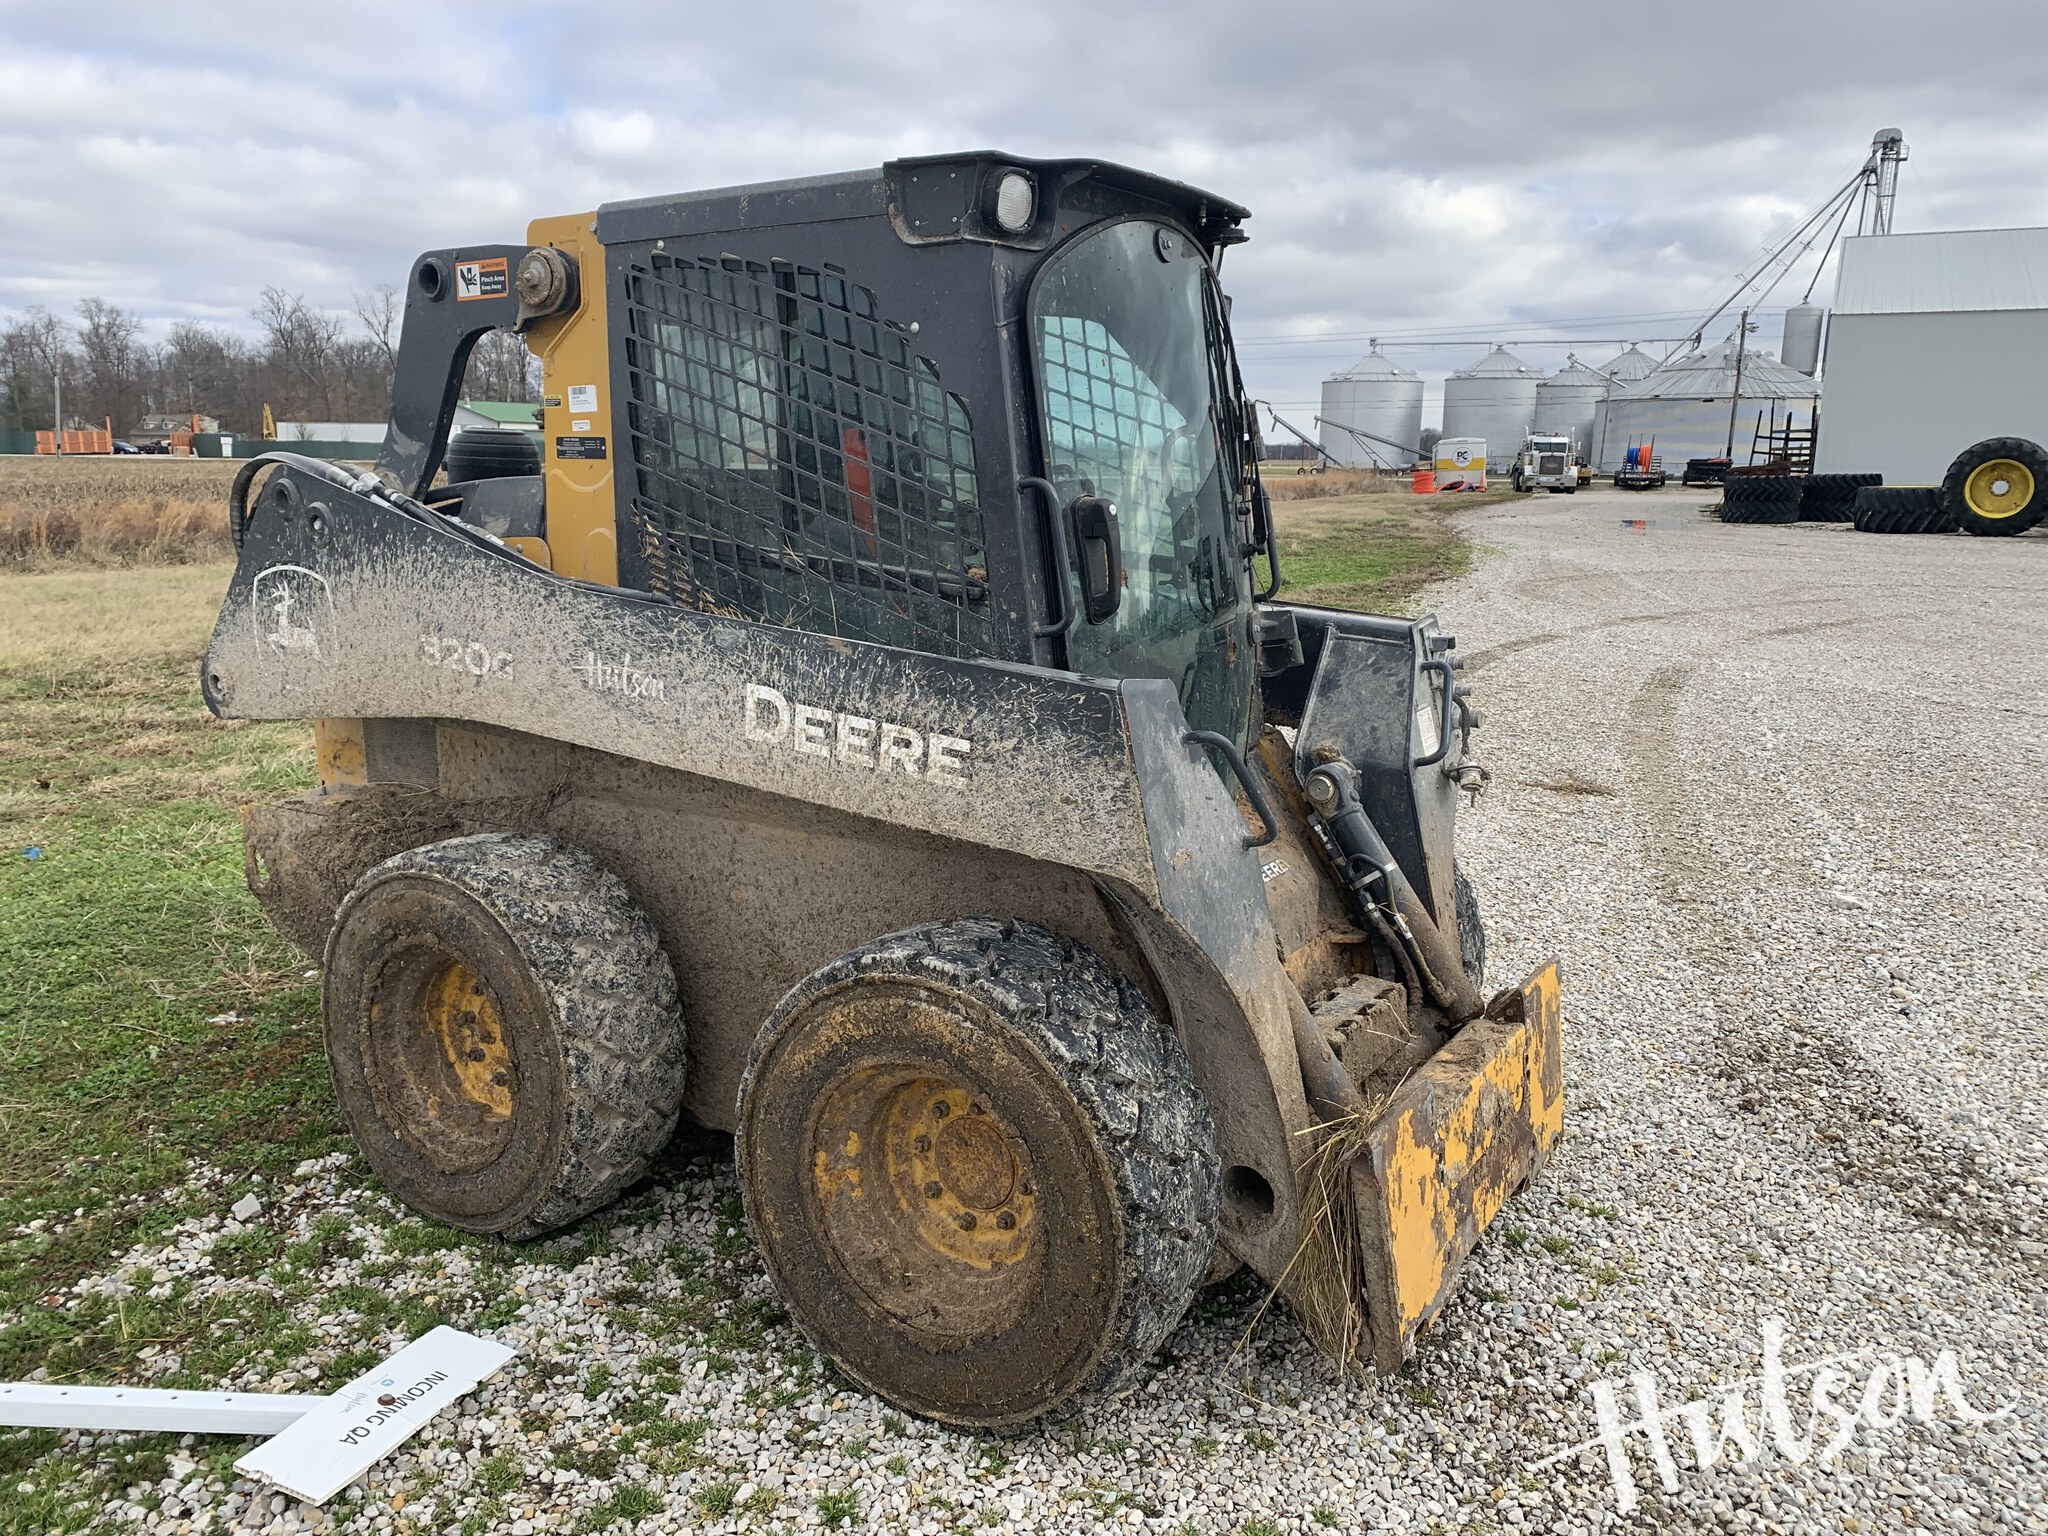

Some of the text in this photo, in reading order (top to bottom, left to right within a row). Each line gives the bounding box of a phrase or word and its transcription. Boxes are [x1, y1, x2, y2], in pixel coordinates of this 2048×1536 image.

[572, 651, 668, 704] Hutson
[746, 682, 971, 788] DEERE
[339, 1370, 449, 1446] INCOMING QA
